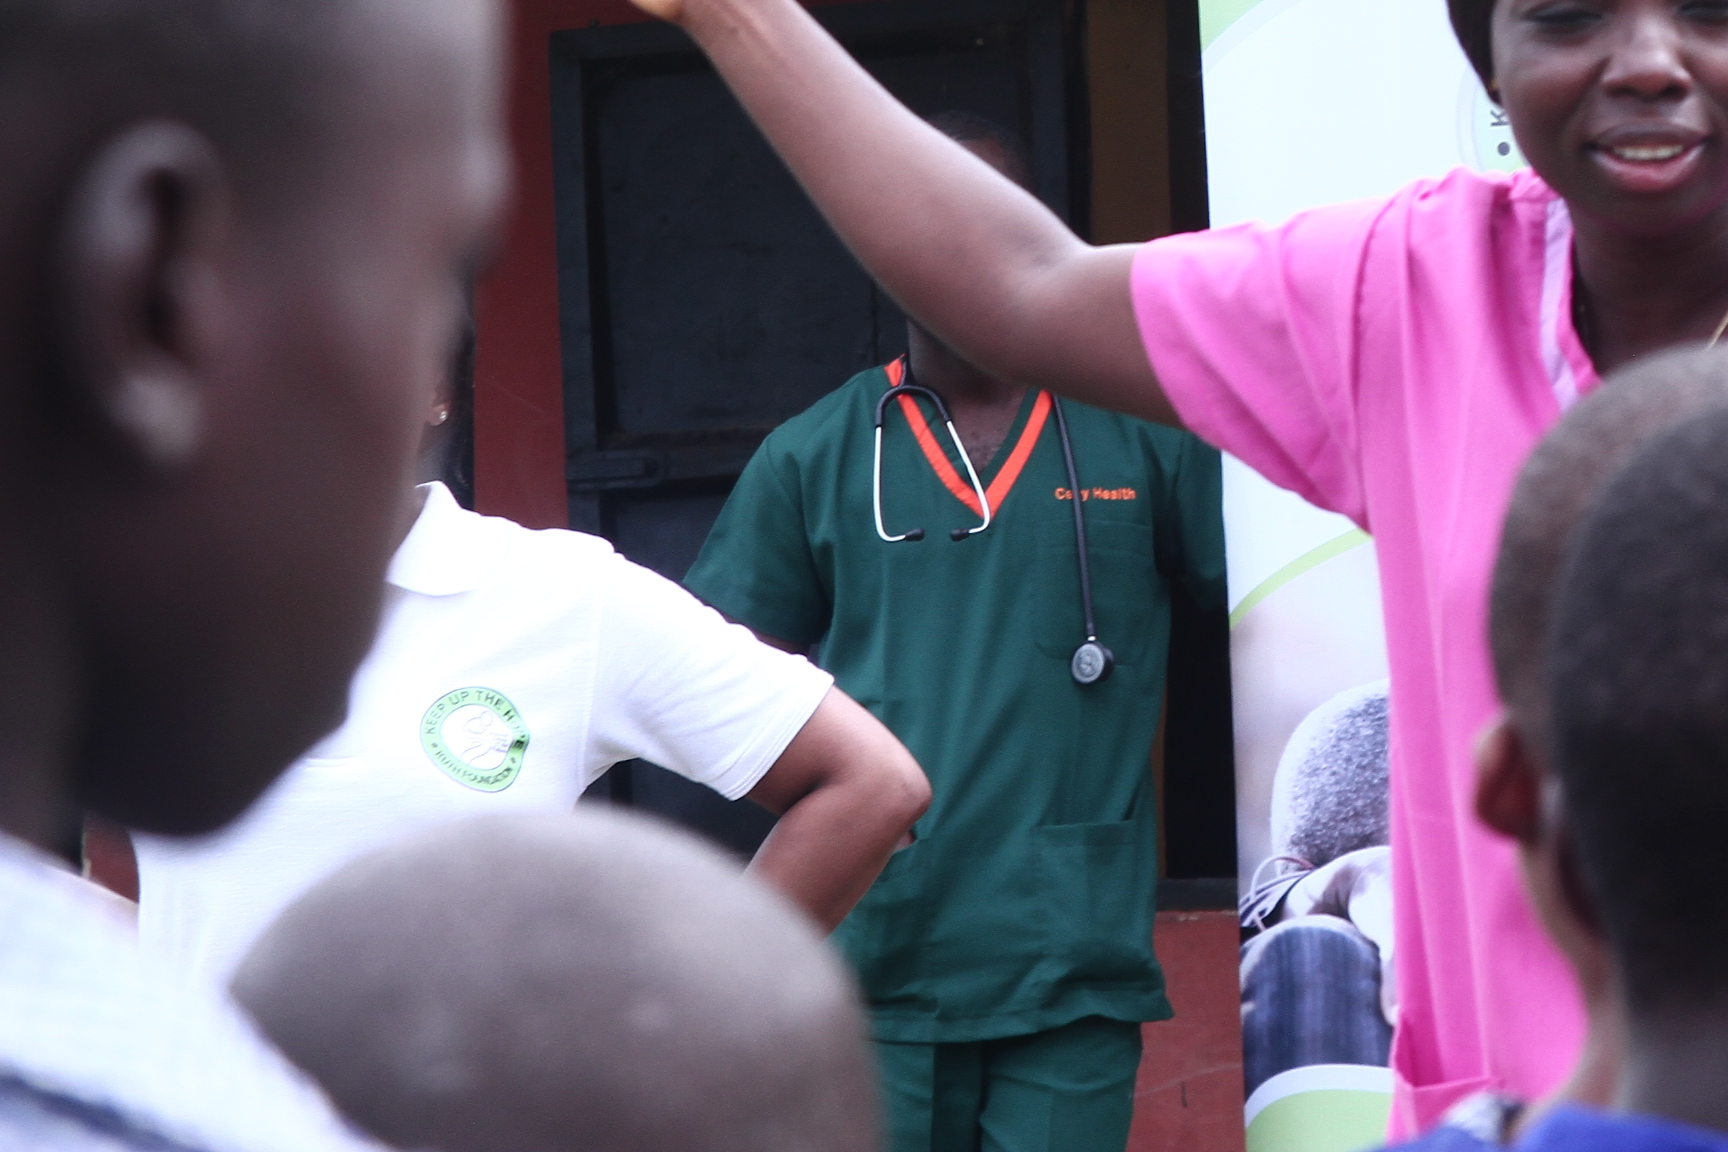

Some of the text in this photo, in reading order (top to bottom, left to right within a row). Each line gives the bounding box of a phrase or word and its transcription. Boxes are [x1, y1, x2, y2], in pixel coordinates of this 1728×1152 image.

[1092, 487, 1136, 500] Health
[425, 703, 446, 735] KEEP
[448, 691, 470, 705] UP
[475, 690, 505, 711] THE
